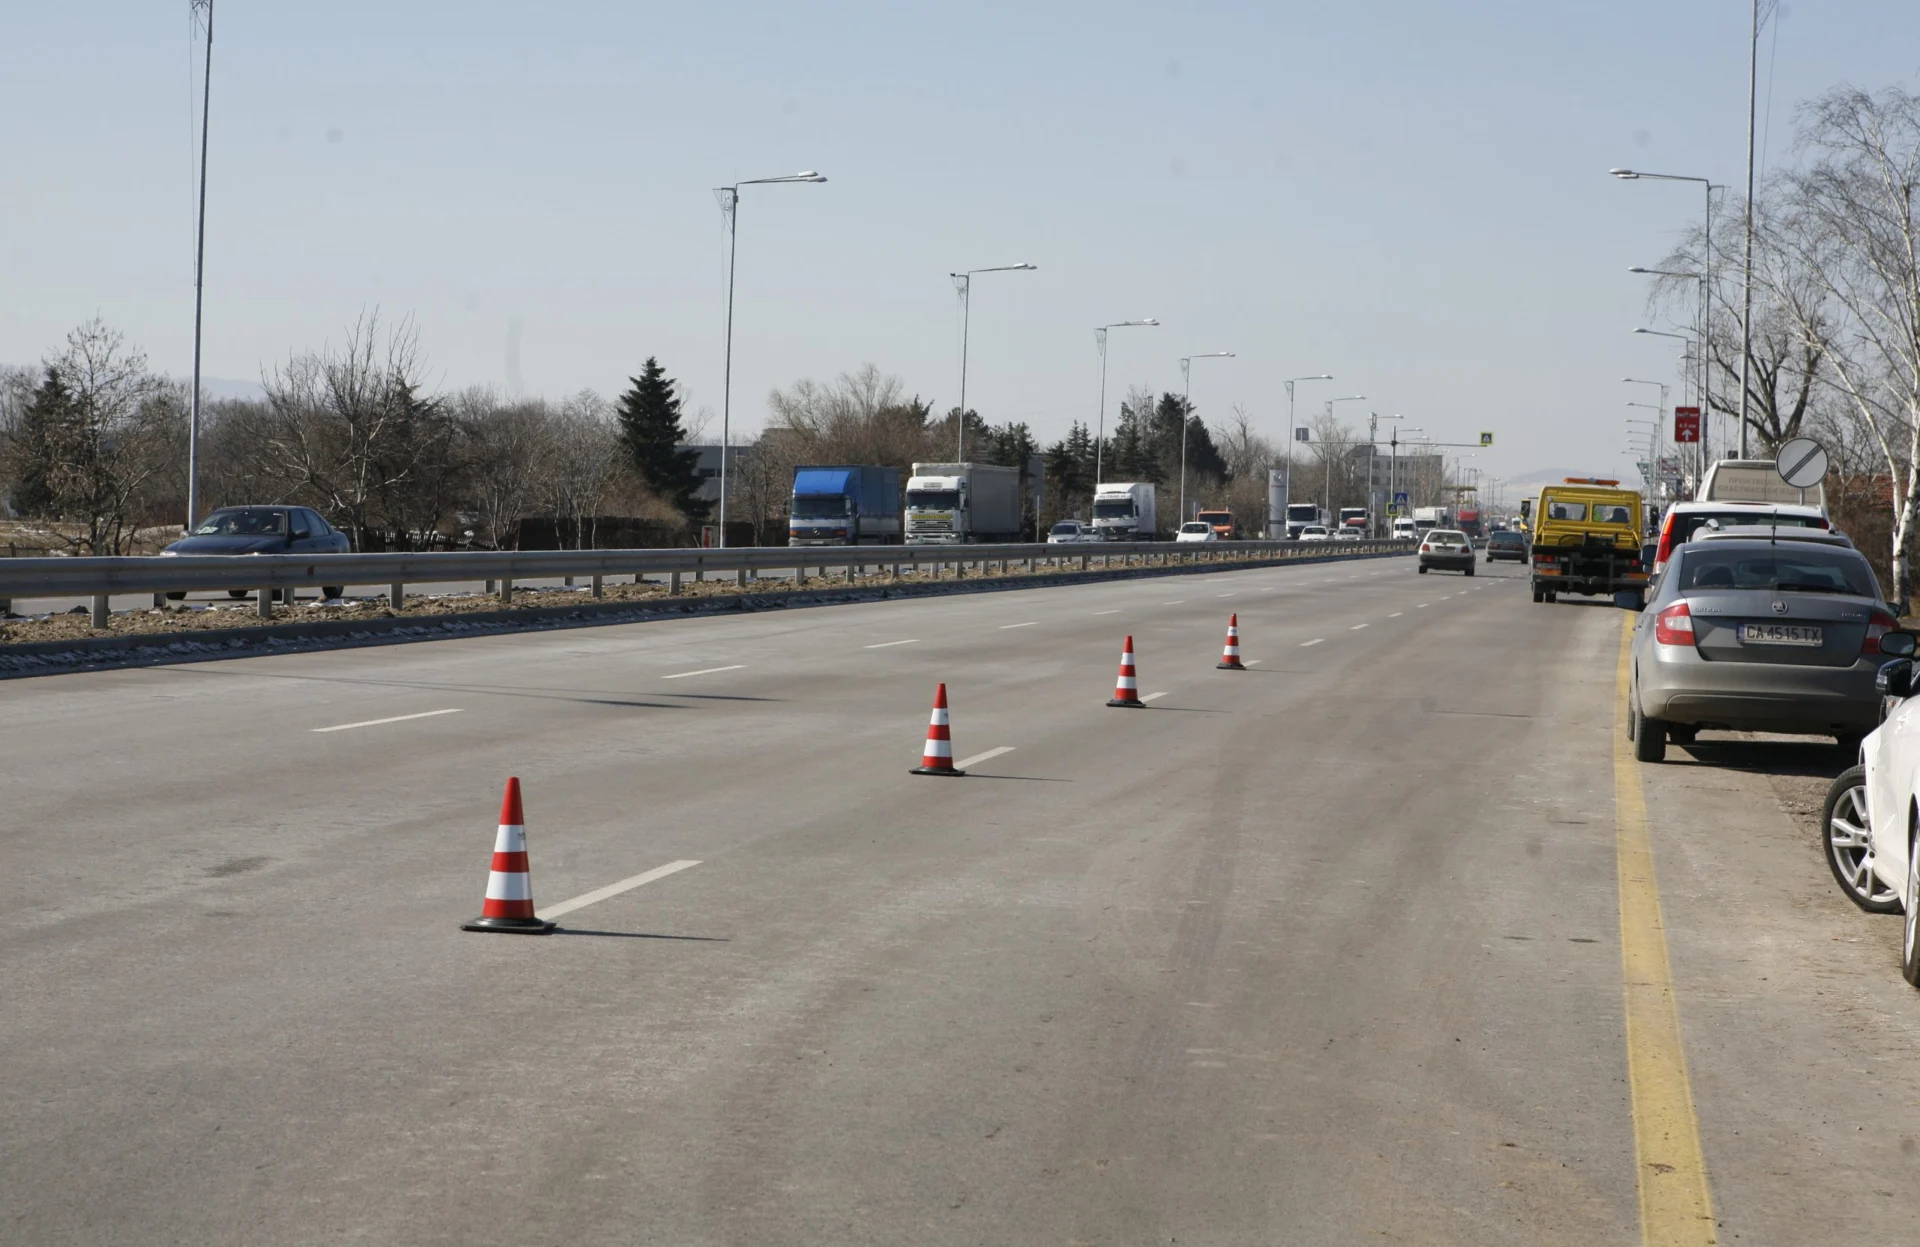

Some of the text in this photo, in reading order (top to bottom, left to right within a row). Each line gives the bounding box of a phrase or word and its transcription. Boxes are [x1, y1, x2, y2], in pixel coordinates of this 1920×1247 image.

[1746, 625, 1820, 641] CA 4515 TX
